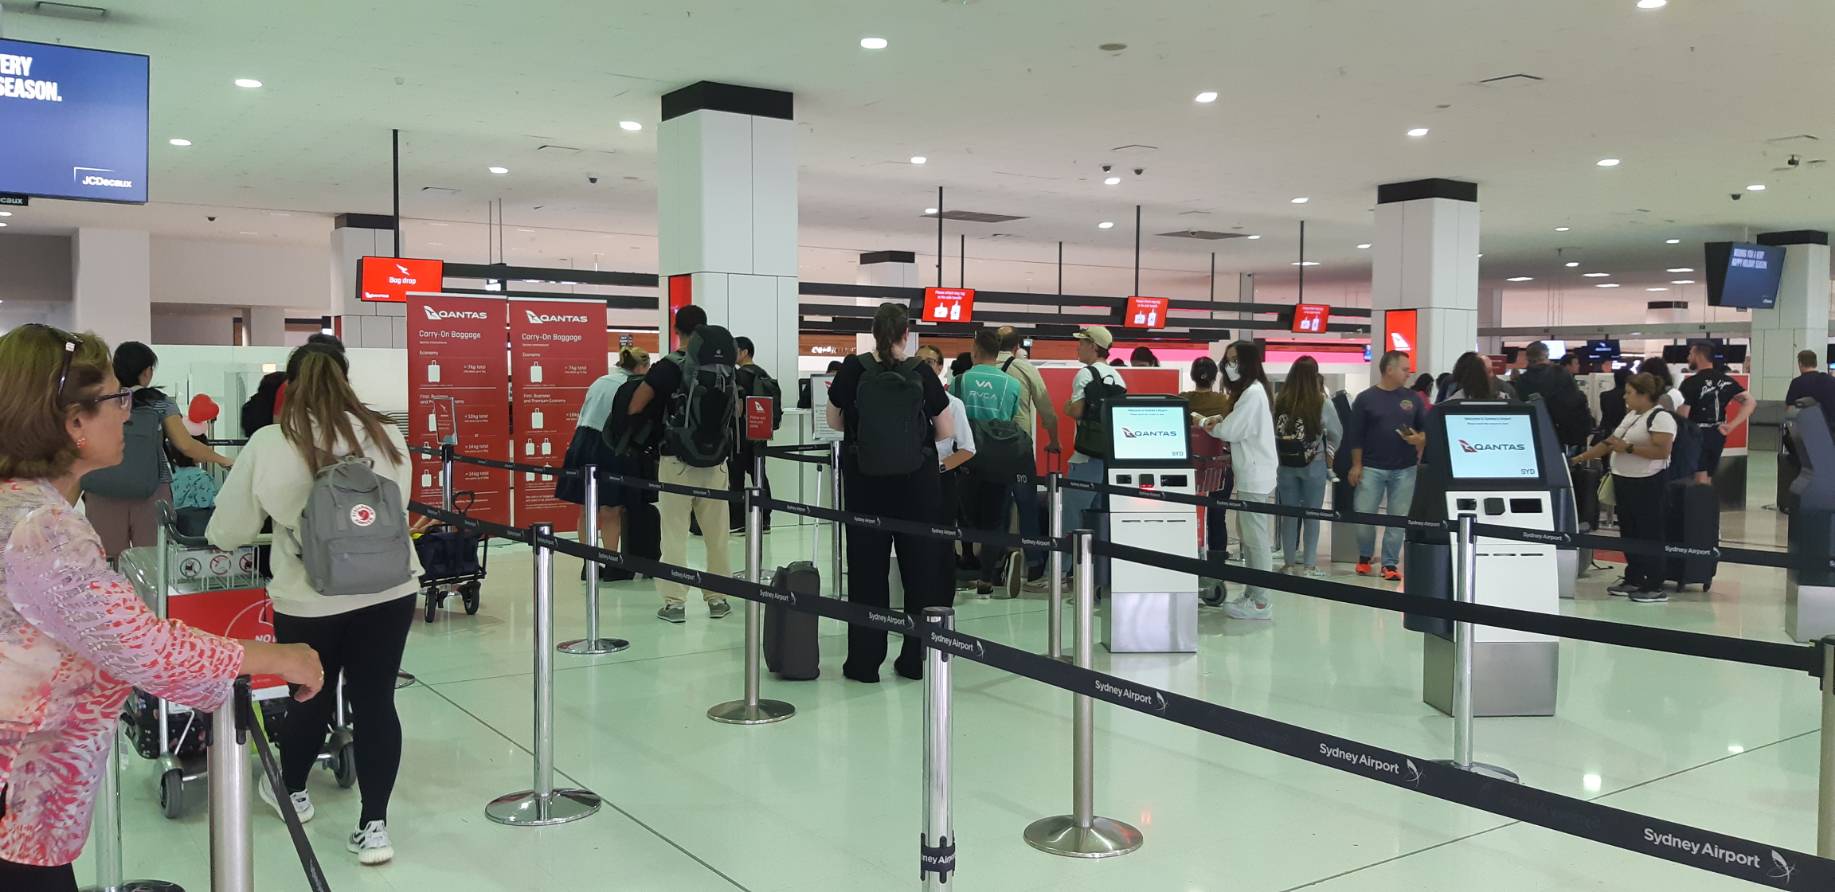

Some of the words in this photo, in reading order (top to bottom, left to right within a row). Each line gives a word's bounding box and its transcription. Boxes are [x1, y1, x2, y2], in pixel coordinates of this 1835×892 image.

[0, 53, 32, 76] ERY
[0, 76, 62, 102] SEASON.
[82, 176, 132, 188] JCDecaux
[389, 276, 401, 284] Bag
[402, 277, 416, 285] drop
[438, 310, 488, 319] QANTAS
[540, 314, 588, 322] QANTAS
[419, 330, 450, 340] Carry-On
[451, 331, 481, 340] Baggage
[553, 334, 582, 342] Baggage
[976, 380, 992, 389] VA
[968, 390, 997, 400] RVCA
[1522, 531, 1542, 539] Sydney
[1664, 545, 1687, 554] Sydney
[1687, 548, 1710, 556] Airport
[760, 589, 774, 599] Sydney
[774, 592, 789, 601] Airport
[868, 612, 887, 623] Sydney
[887, 615, 905, 626] Airport
[931, 632, 952, 646] Sydney
[952, 638, 974, 651] Airport
[1095, 680, 1122, 697] Sydney
[1123, 688, 1152, 704] Airport
[1320, 743, 1358, 764] Sydney
[1359, 754, 1399, 774] Airport
[1644, 828, 1700, 855] Sydney
[1701, 843, 1761, 868] Airport
[922, 856, 938, 864] ney
